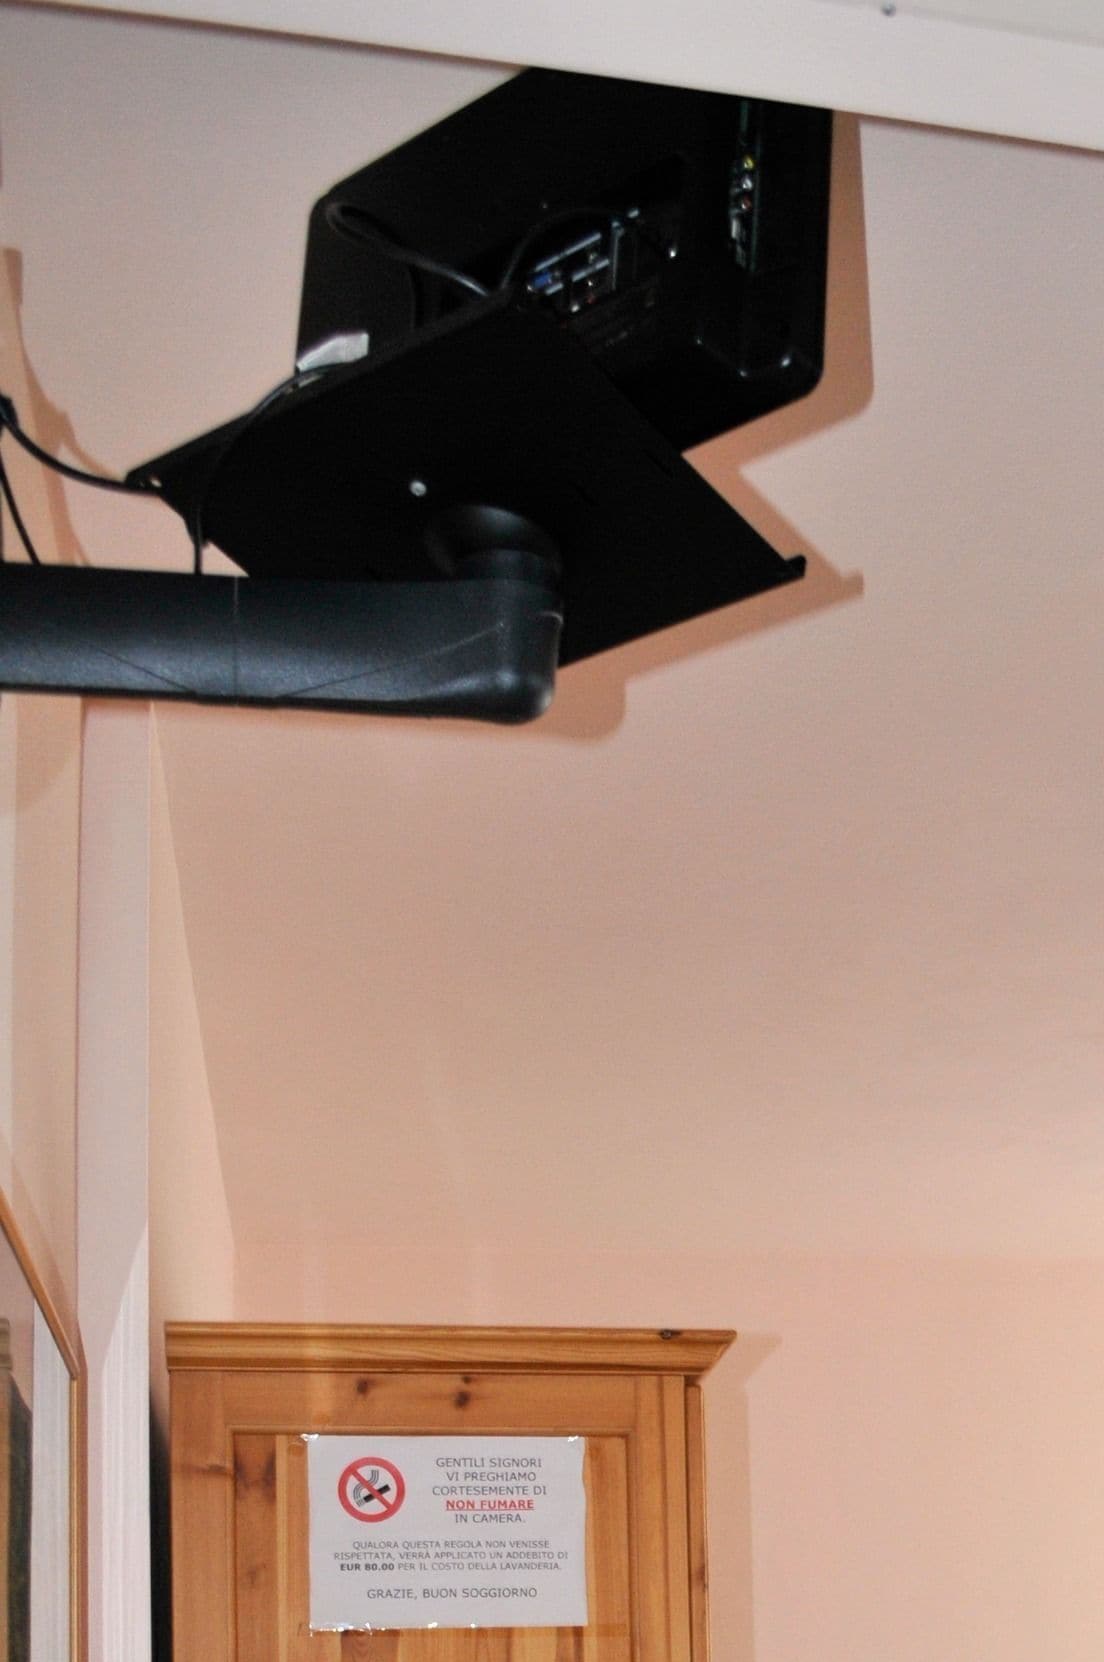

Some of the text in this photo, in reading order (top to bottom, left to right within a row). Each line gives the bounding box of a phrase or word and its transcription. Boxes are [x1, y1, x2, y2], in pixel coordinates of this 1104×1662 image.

[436, 1458, 542, 1467] GENTILI SIGNORI
[447, 1472, 536, 1482] VI PREGHIAMO
[432, 1486, 546, 1496] CORTESEMENTE DI
[446, 1500, 534, 1510] NON FUMARE
[455, 1513, 525, 1523] IN CAMERA.
[352, 1540, 550, 1550] QUALORA QUESTA REGOLA NON VENISSE
[334, 1551, 395, 1561] RISPETTATA,
[434, 1552, 486, 1560] APPLICATO
[490, 1552, 502, 1560] UN
[506, 1551, 554, 1560] ADDEBITO
[558, 1551, 568, 1559] DI
[340, 1563, 361, 1571] EUR
[364, 1563, 394, 1571] 80.00
[398, 1562, 415, 1570] PER
[420, 1562, 428, 1570] IL
[431, 1562, 465, 1571] COSTO
[468, 1562, 496, 1570] DELLA
[367, 1588, 537, 1600] GRAZIE, BUON SOGGIORNO
